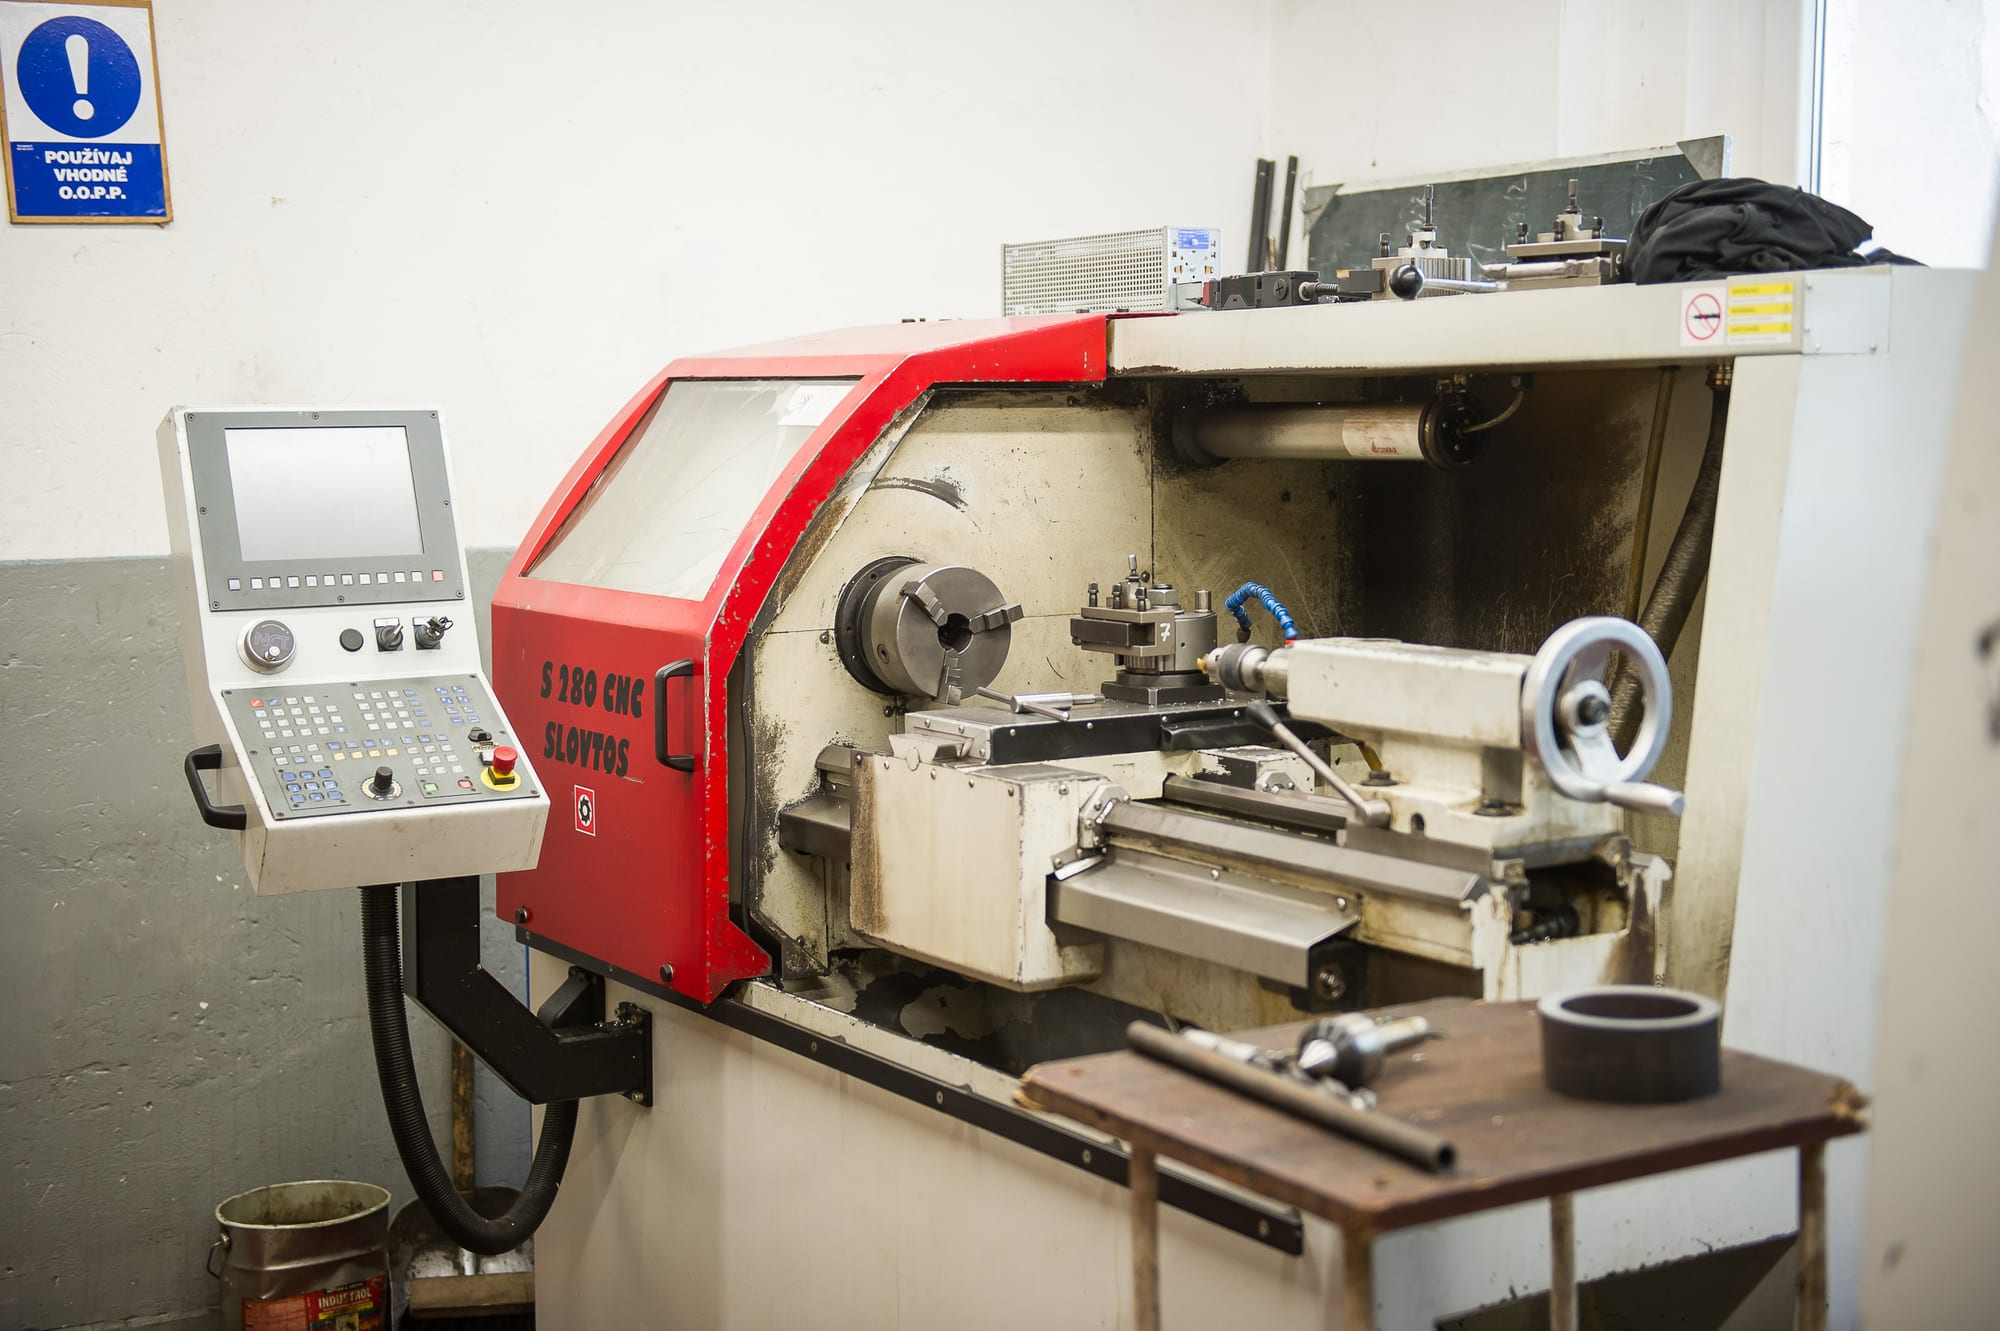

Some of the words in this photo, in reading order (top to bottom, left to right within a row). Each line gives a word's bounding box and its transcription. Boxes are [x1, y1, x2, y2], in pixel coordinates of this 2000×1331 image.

[44, 147, 133, 166] POUŽÍVAJ
[53, 166, 129, 182] VHODNÉ
[58, 185, 127, 200] O.O.P.P.
[1159, 622, 1171, 643] 7
[540, 660, 553, 699] S
[557, 663, 598, 708] 280
[603, 672, 645, 719] CNC
[543, 720, 630, 778] SLOVTOS
